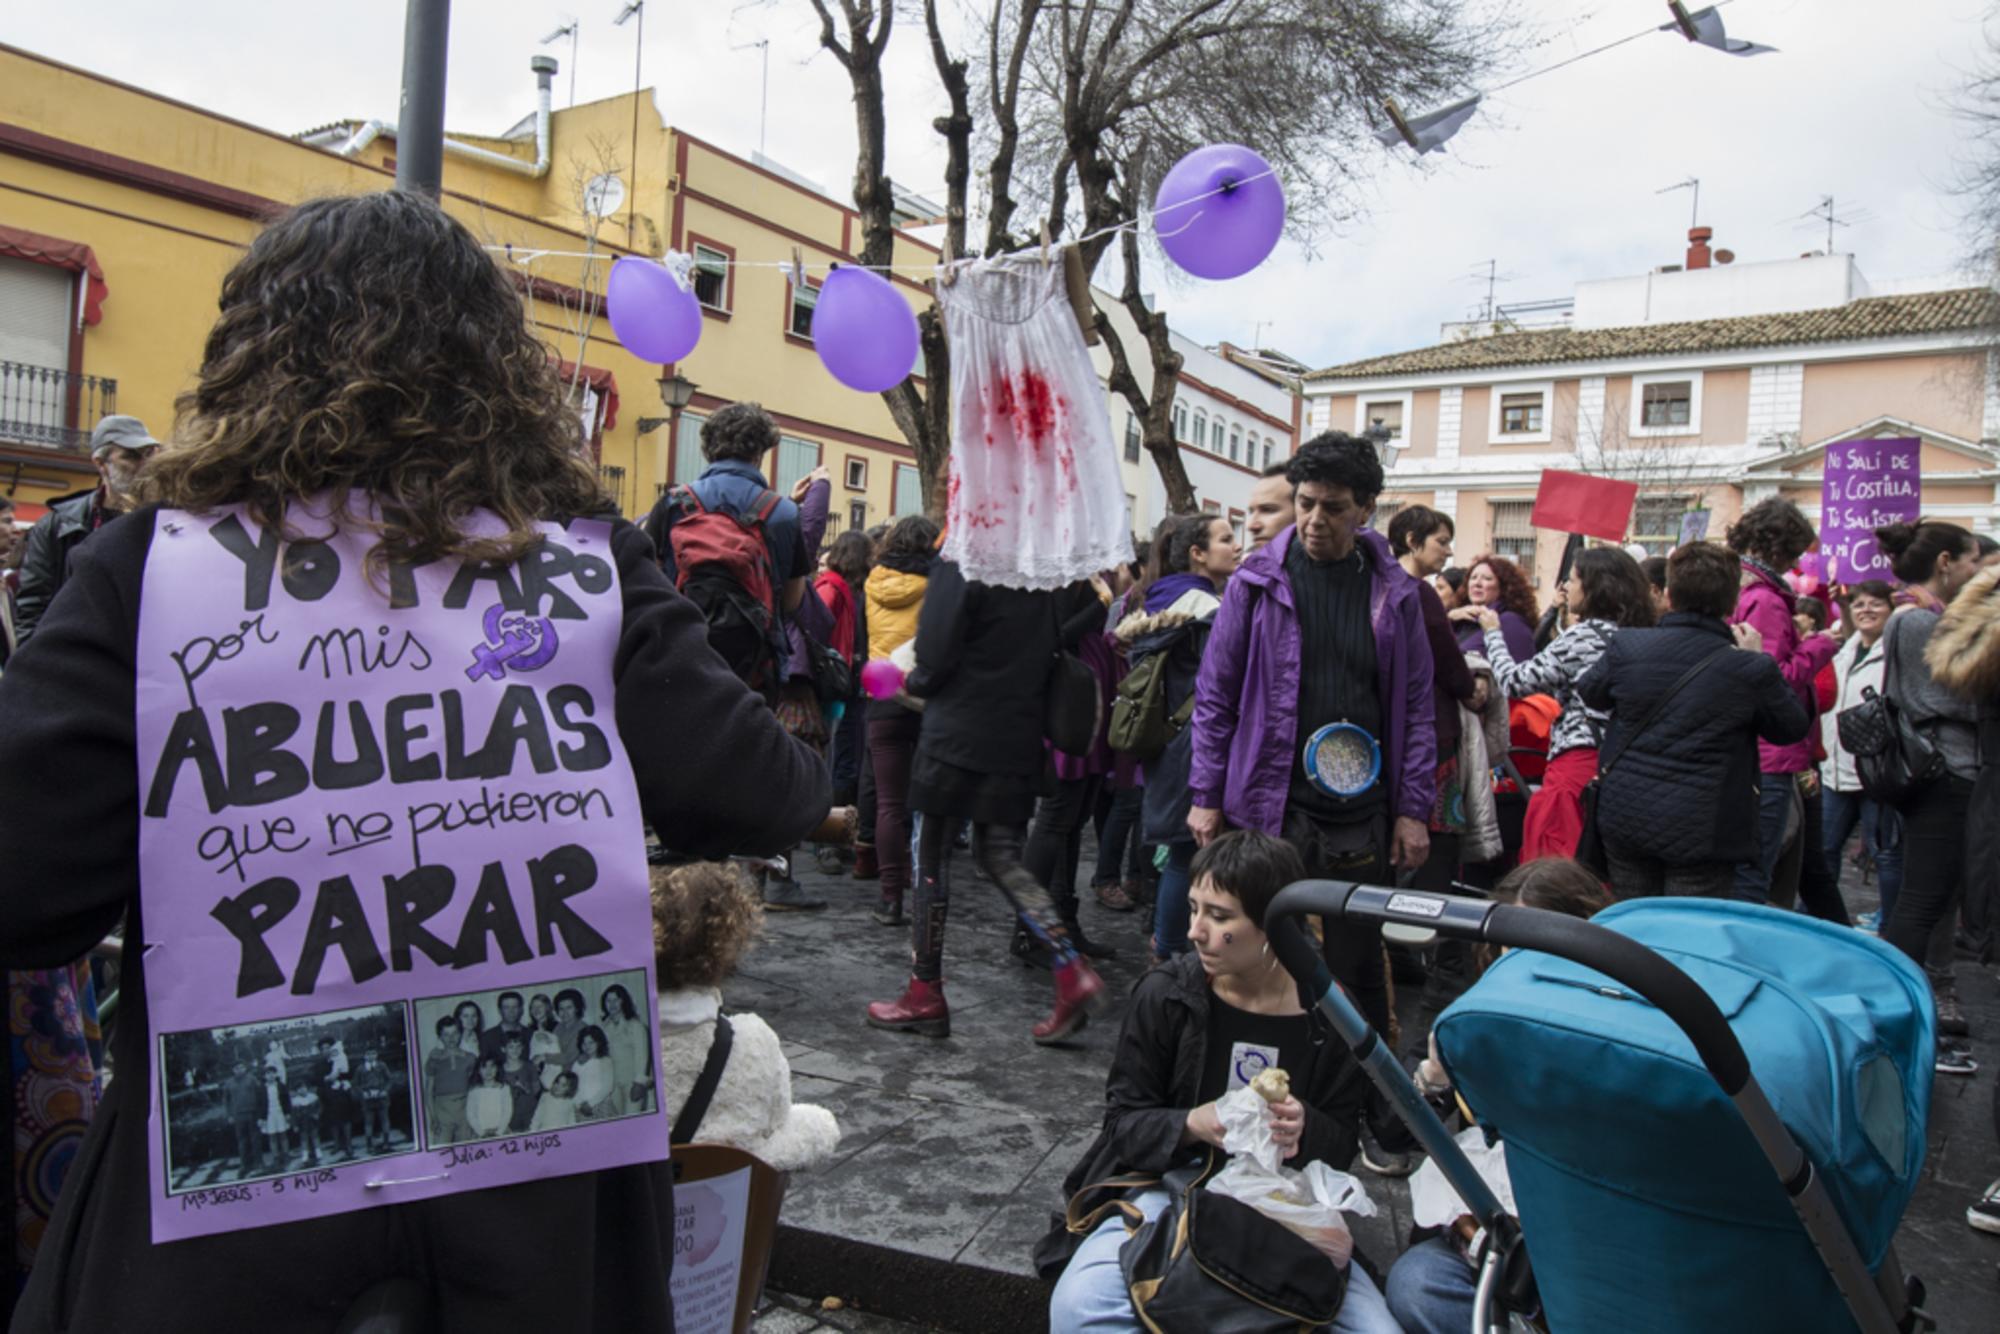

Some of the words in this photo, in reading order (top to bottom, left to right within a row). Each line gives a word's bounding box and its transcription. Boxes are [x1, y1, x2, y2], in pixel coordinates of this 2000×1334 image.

[1891, 454, 1911, 470] DE
[208, 510, 341, 612] YO
[382, 506, 612, 620] PARO
[170, 614, 280, 710] por
[299, 625, 432, 679] mis
[144, 684, 612, 818] ABUELAS
[197, 816, 310, 882] que
[327, 810, 393, 846] no
[408, 787, 614, 868] pudieron
[209, 843, 614, 998] PARAR
[294, 1168, 338, 1192] hijos
[439, 1147, 493, 1169] Julia:
[499, 1141, 518, 1155] 12
[524, 1134, 563, 1157] hijos
